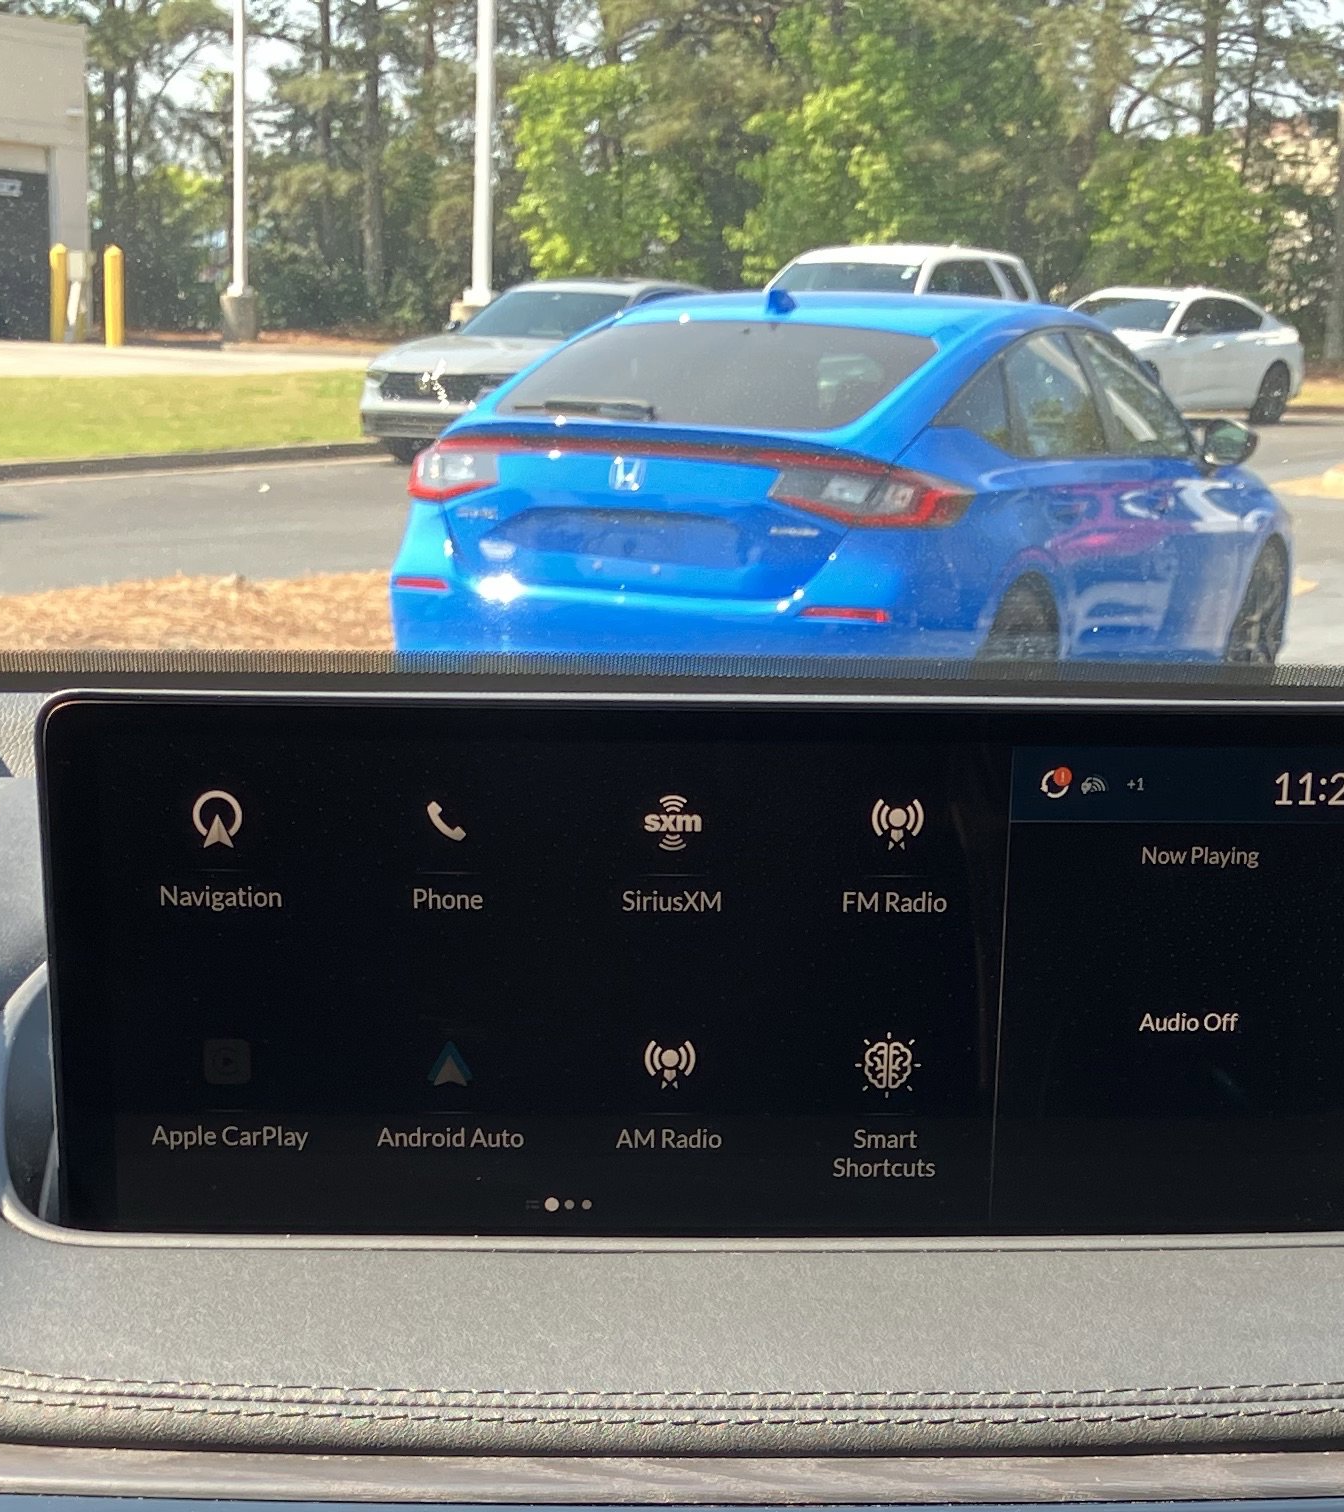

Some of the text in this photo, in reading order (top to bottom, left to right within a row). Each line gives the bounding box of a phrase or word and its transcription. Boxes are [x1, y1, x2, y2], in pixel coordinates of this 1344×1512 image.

[1141, 844, 1260, 870] Now Playing
[159, 884, 283, 912] Navigation
[412, 887, 484, 912] Phone
[622, 889, 723, 913] SiriusXM
[842, 890, 948, 914] FM Radio
[1138, 1011, 1239, 1033] Audio Off
[152, 1125, 309, 1152] Apple CarPlay
[377, 1126, 525, 1149] Android Auto
[615, 1128, 723, 1150] AM Radio
[853, 1128, 918, 1151] Smart
[832, 1157, 937, 1180] Shortcuts
